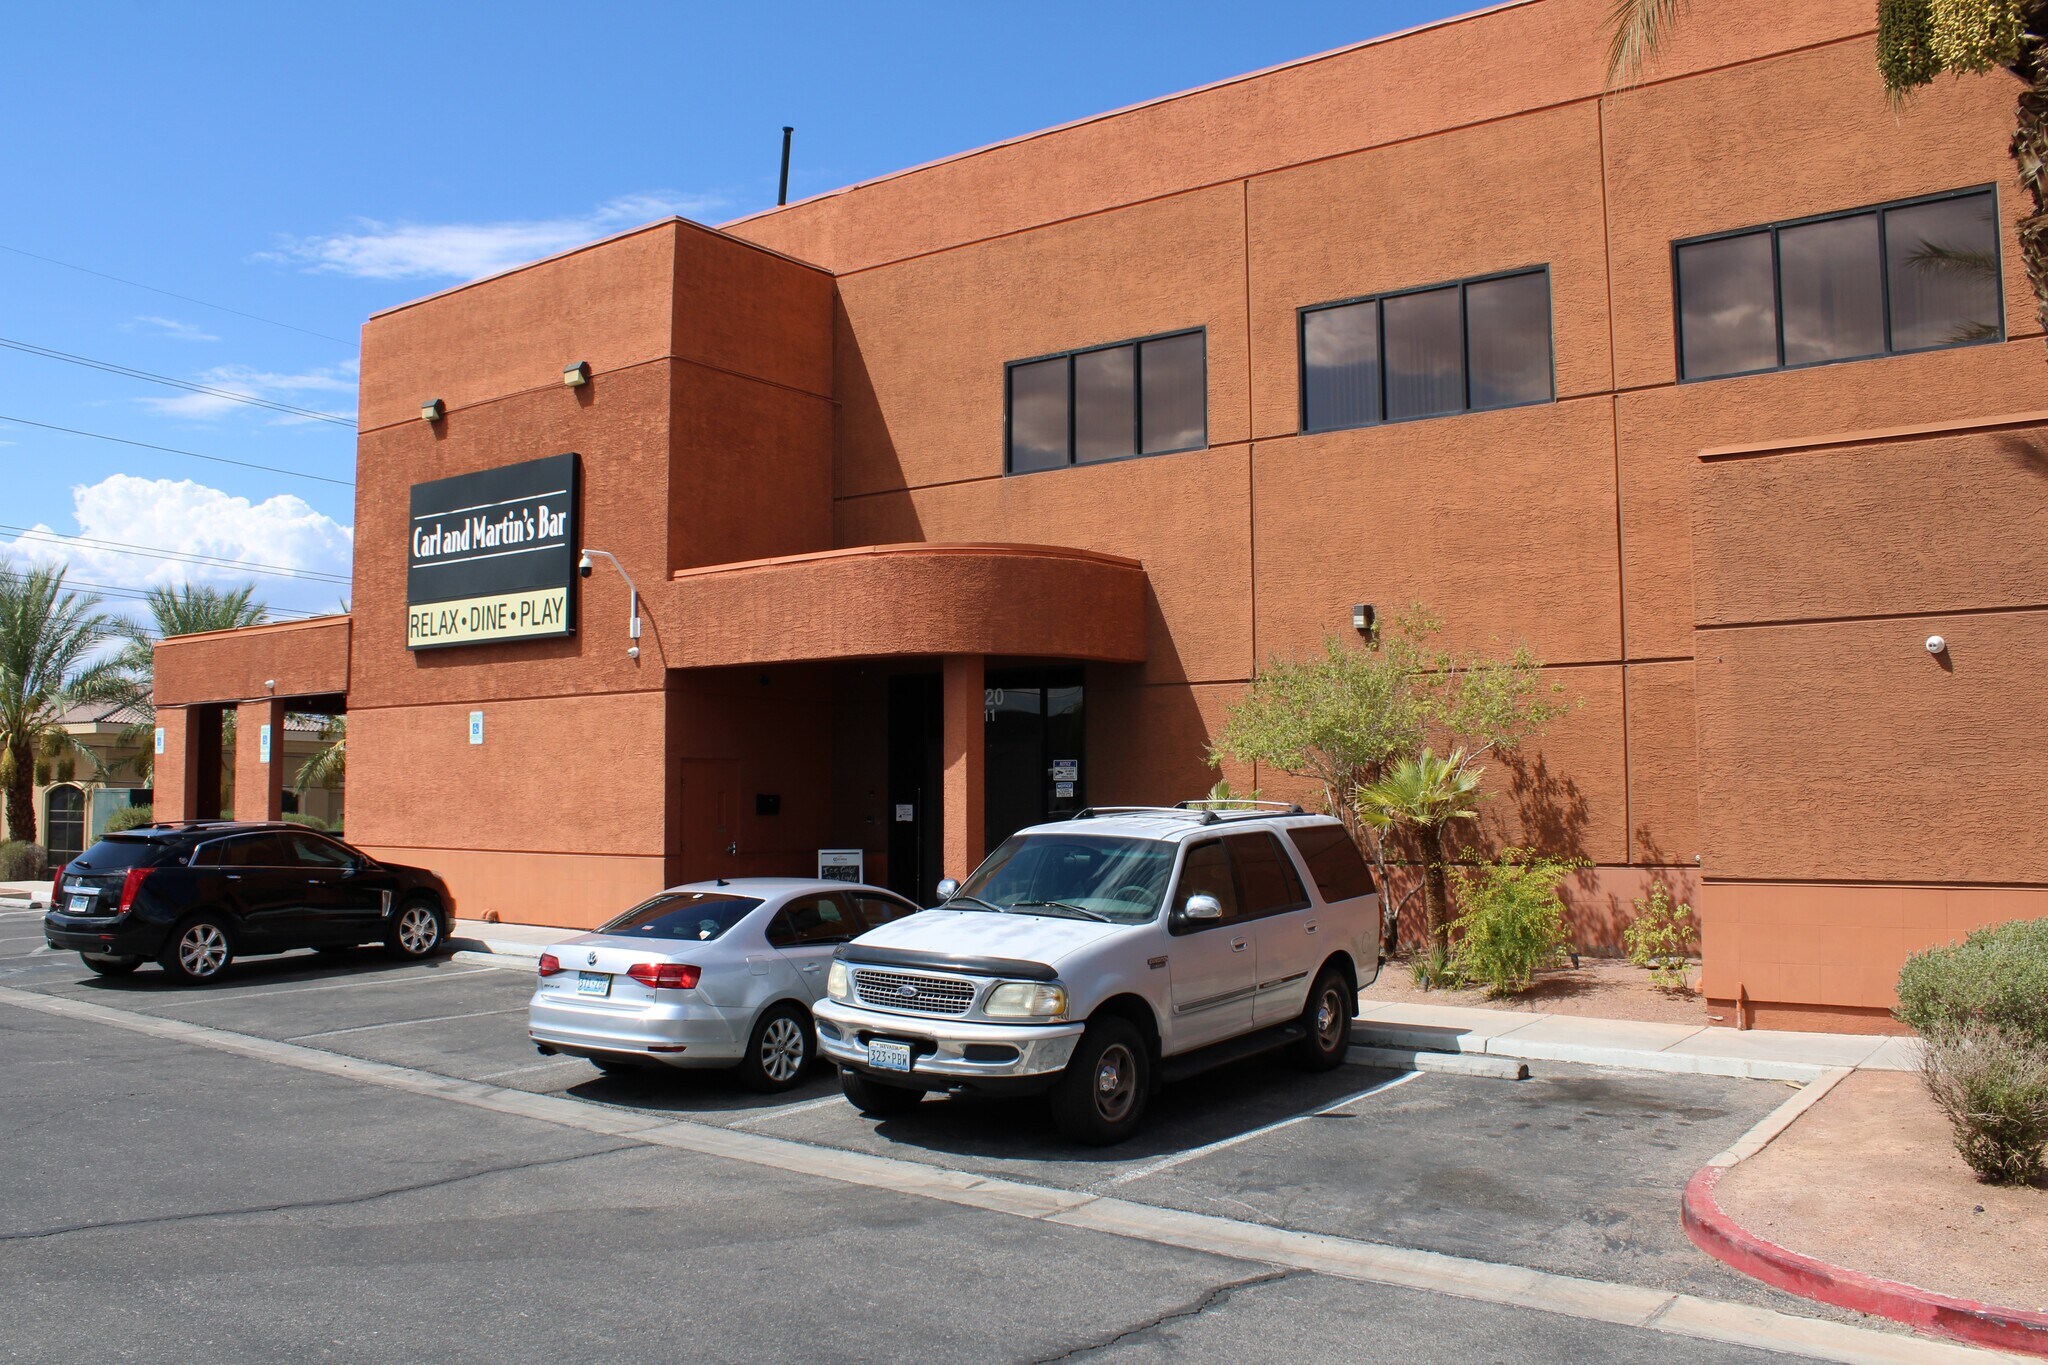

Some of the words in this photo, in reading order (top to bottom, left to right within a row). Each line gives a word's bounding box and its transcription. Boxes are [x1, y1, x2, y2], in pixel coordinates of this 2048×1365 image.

[412, 523, 441, 558] Carl
[443, 518, 470, 552] and
[473, 508, 535, 549] Martin's
[538, 505, 567, 539] Bar
[410, 608, 458, 638] RELAX
[470, 603, 507, 632] DINE
[520, 596, 564, 627] PLAY
[985, 688, 1004, 705] 20
